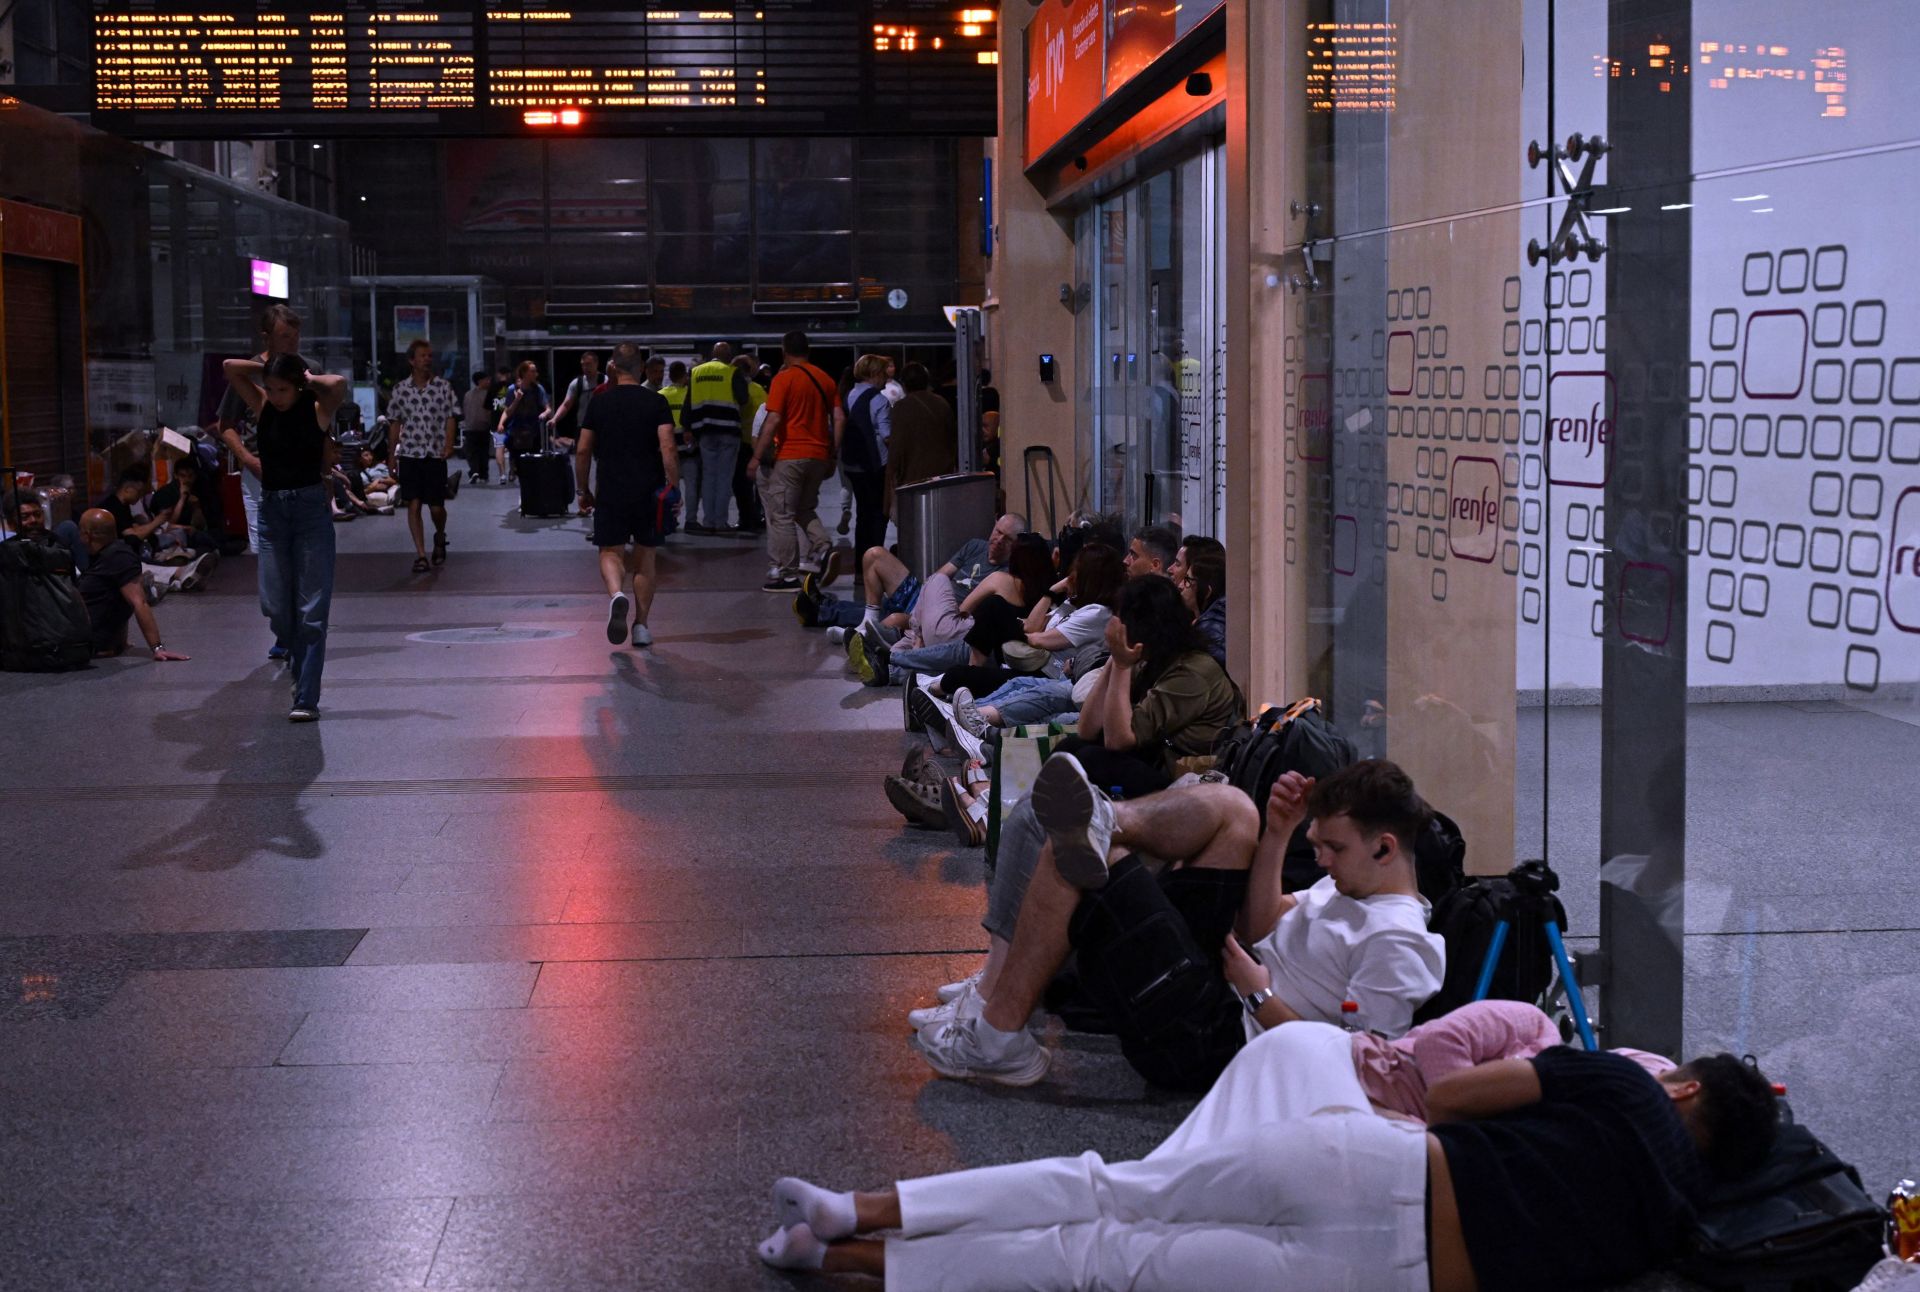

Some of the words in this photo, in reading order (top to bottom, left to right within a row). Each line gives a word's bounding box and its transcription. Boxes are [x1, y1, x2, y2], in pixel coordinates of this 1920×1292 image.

[1046, 21, 1065, 113] iryo
[1549, 402, 1613, 458] renfe
[1452, 486, 1498, 535] renfe
